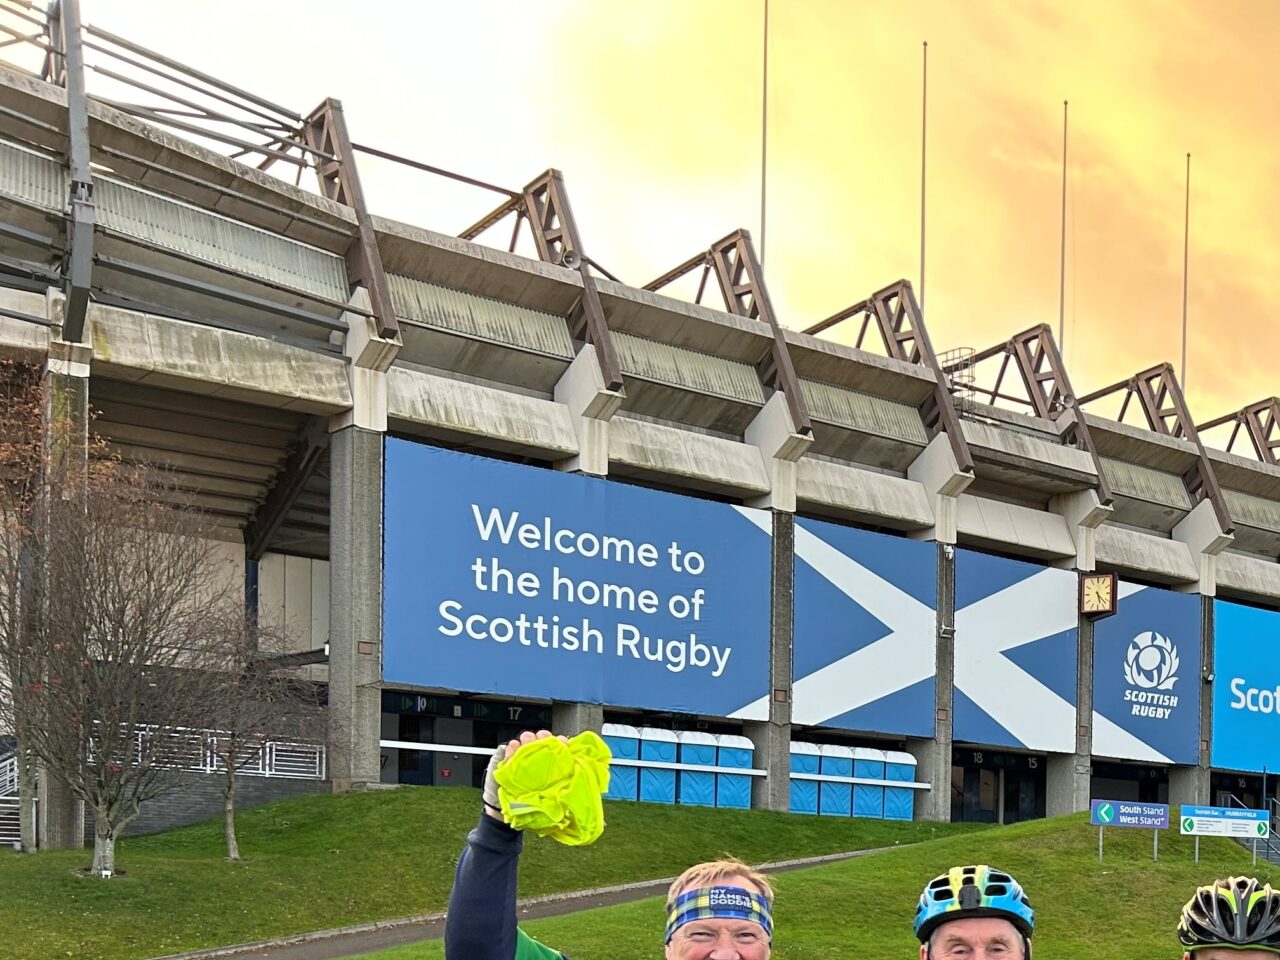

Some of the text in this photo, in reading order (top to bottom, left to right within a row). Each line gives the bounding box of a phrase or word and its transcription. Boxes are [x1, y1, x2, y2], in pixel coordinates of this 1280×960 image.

[472, 504, 705, 575] Welcome to
[471, 557, 705, 620] the home of
[438, 600, 732, 677] Scottish Rugby
[1124, 689, 1179, 707] SCOTTISH
[508, 706, 523, 721] 17
[1131, 704, 1172, 719] RUGBY
[1027, 757, 1038, 769] 15
[1120, 805, 1164, 815] South Stand
[1120, 815, 1139, 824] West
[710, 893, 751, 902] NAME'S
[710, 899, 752, 908] DODDIE
